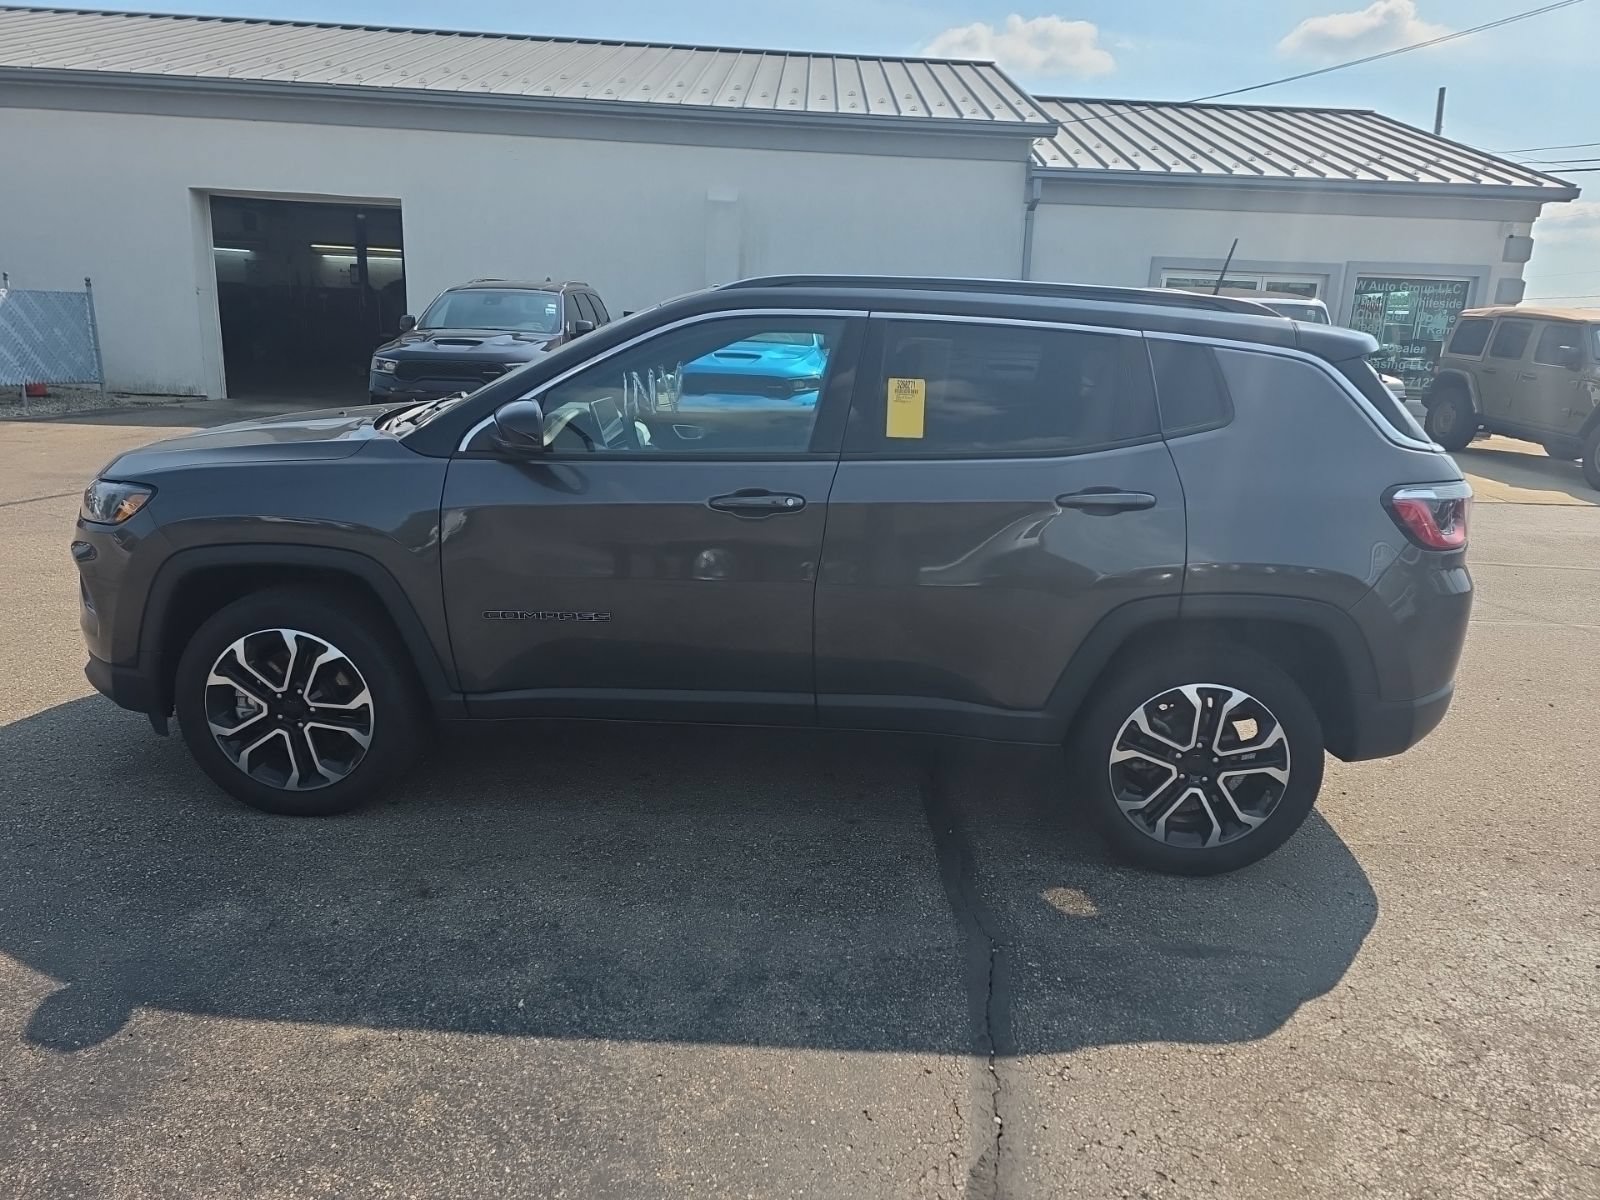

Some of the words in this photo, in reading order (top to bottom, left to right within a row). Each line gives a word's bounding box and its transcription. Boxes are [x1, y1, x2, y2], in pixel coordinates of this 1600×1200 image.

[1368, 281, 1396, 291] Auto
[1399, 282, 1434, 295] Group
[482, 610, 610, 621] COMPASS
